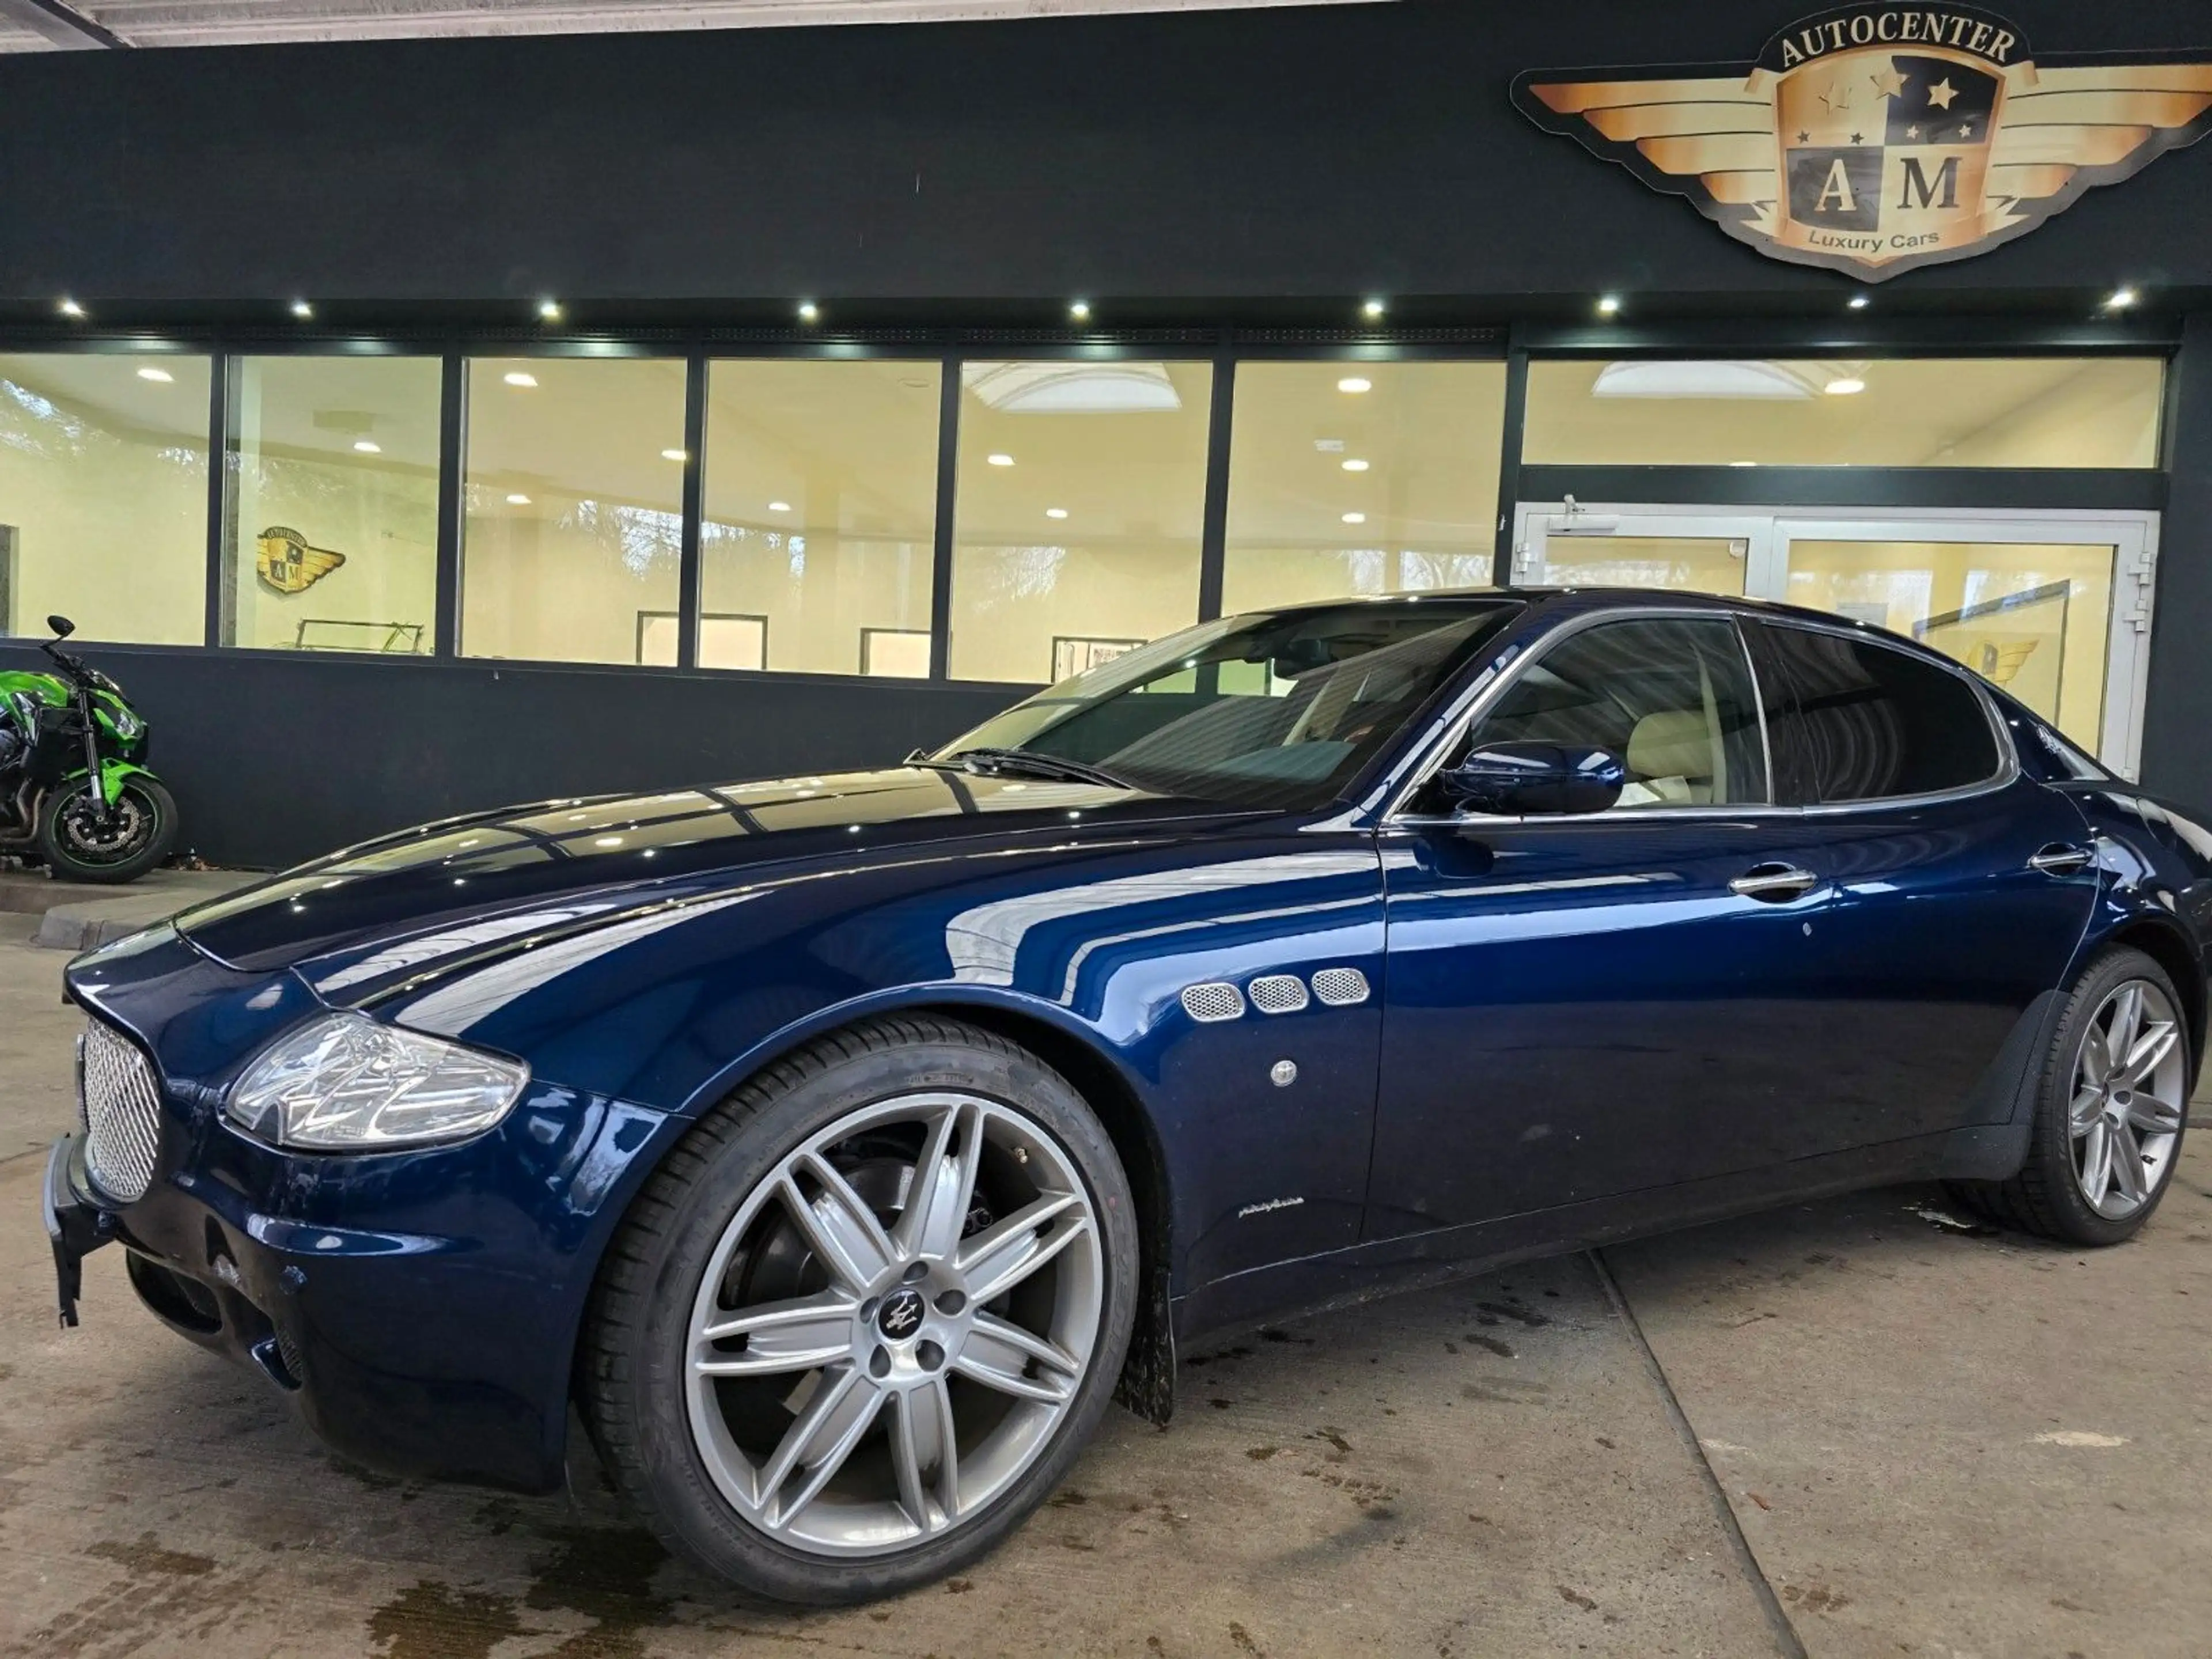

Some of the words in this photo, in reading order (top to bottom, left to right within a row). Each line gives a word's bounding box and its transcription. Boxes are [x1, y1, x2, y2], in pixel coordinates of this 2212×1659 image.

[1782, 12, 2016, 67] AUTOCENTER
[1814, 158, 1858, 211] A
[1896, 156, 1963, 209] M
[1808, 230, 1884, 253] Luxury
[1890, 232, 1940, 249] Cars
